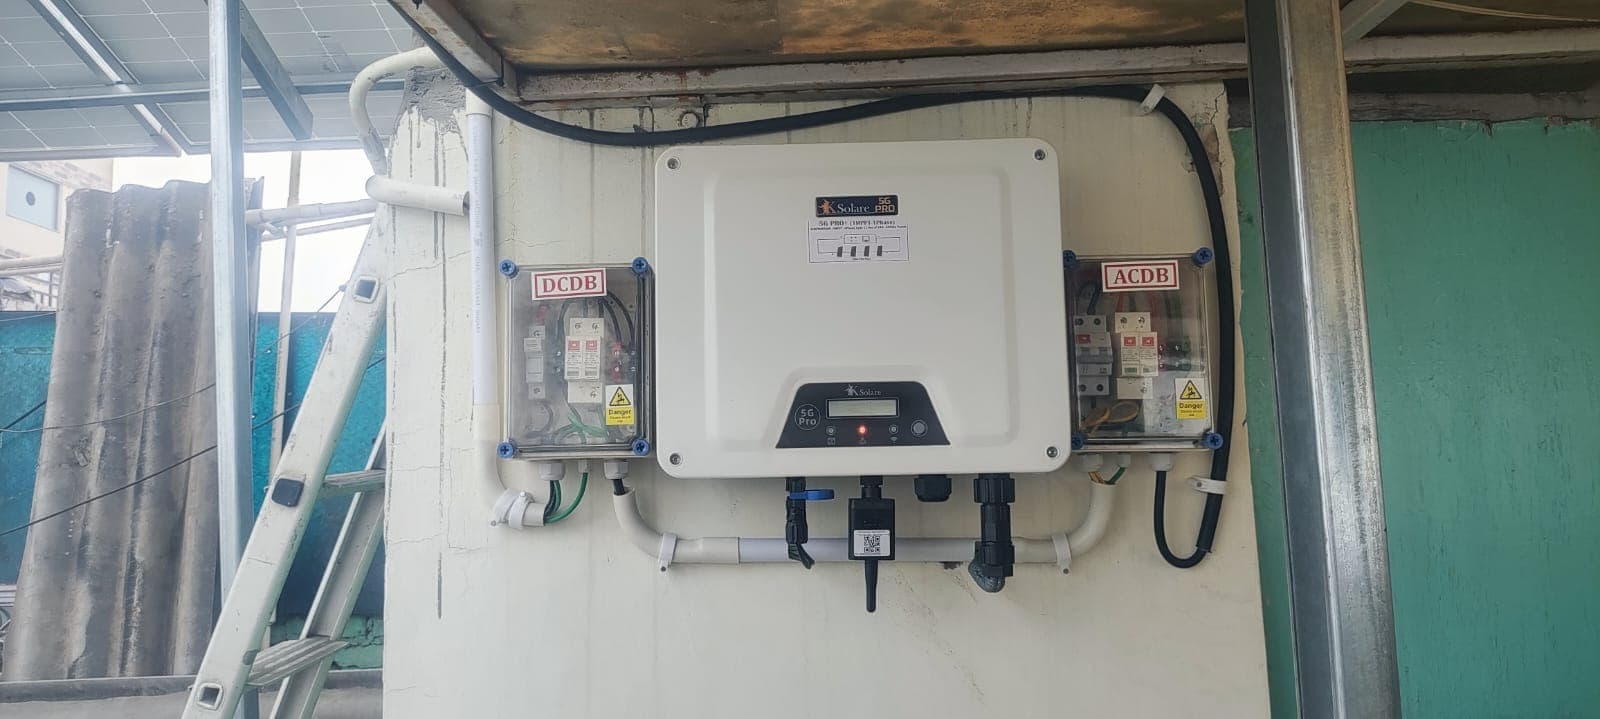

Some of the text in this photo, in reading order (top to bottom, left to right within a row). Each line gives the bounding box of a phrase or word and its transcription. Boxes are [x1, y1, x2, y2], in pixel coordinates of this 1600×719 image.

[837, 203, 870, 213] Solare
[875, 204, 895, 213] PRO
[1114, 267, 1169, 284] ACDB
[542, 275, 597, 293] DCDB
[800, 409, 814, 417] 5G
[799, 417, 816, 426] Pro
